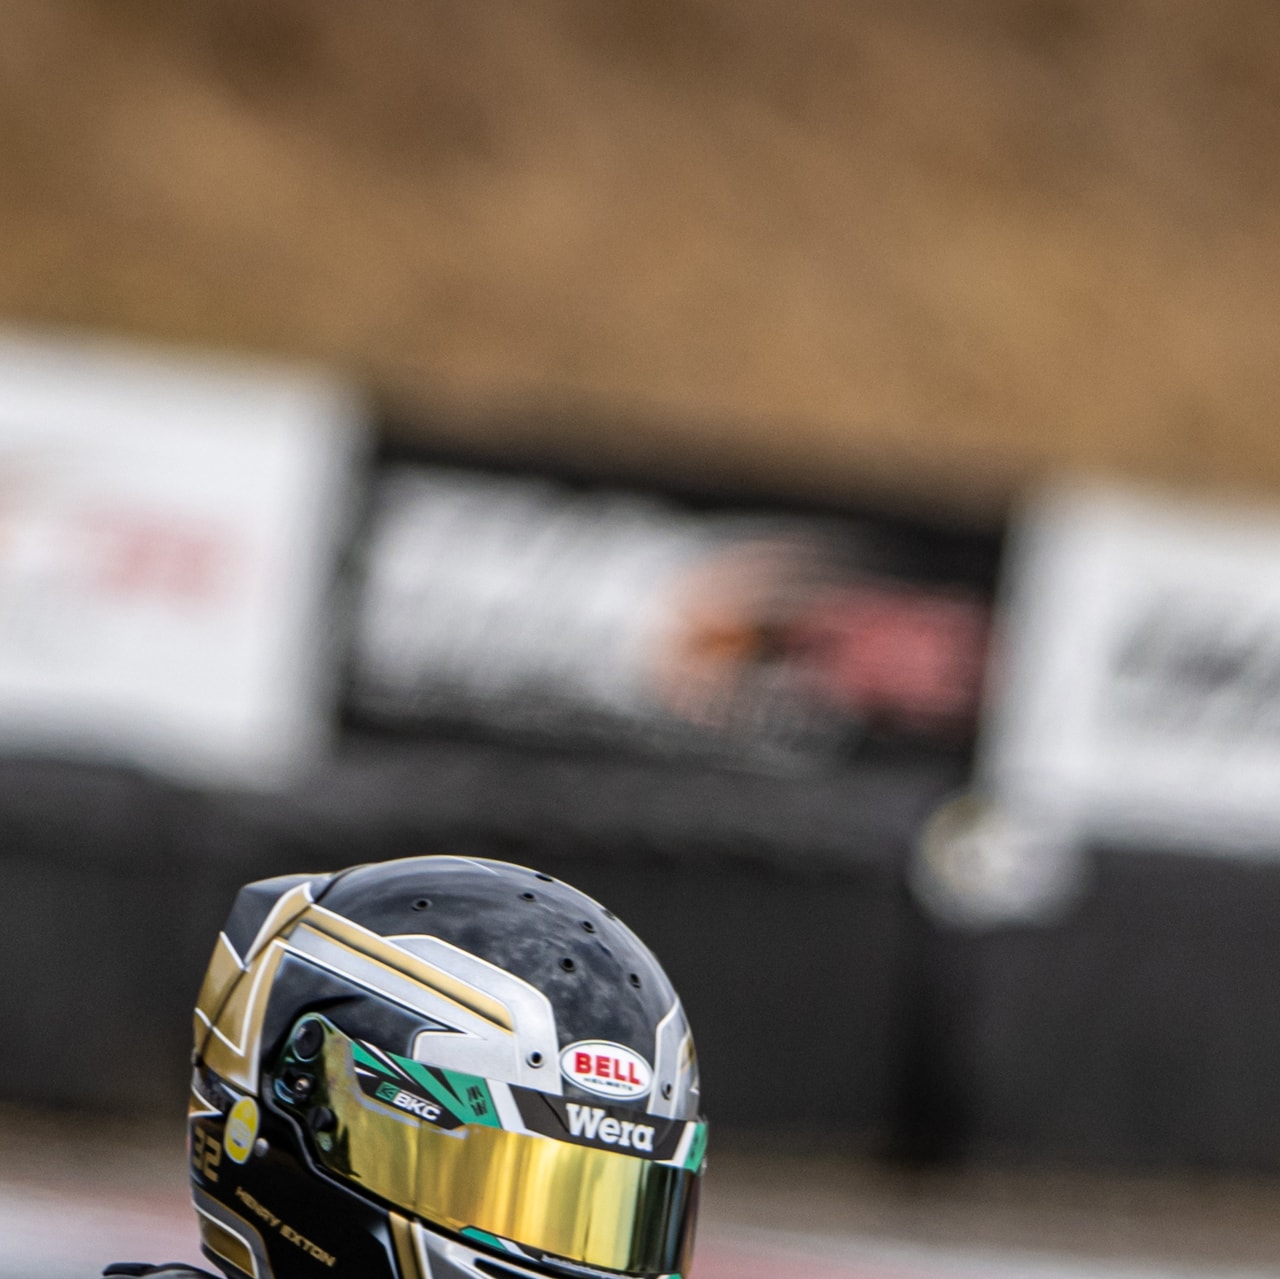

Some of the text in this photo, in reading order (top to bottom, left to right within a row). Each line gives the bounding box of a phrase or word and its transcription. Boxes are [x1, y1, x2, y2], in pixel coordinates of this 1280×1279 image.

[575, 1052, 641, 1085] BELL
[393, 1092, 440, 1120] BKC
[566, 1103, 655, 1152] Wera
